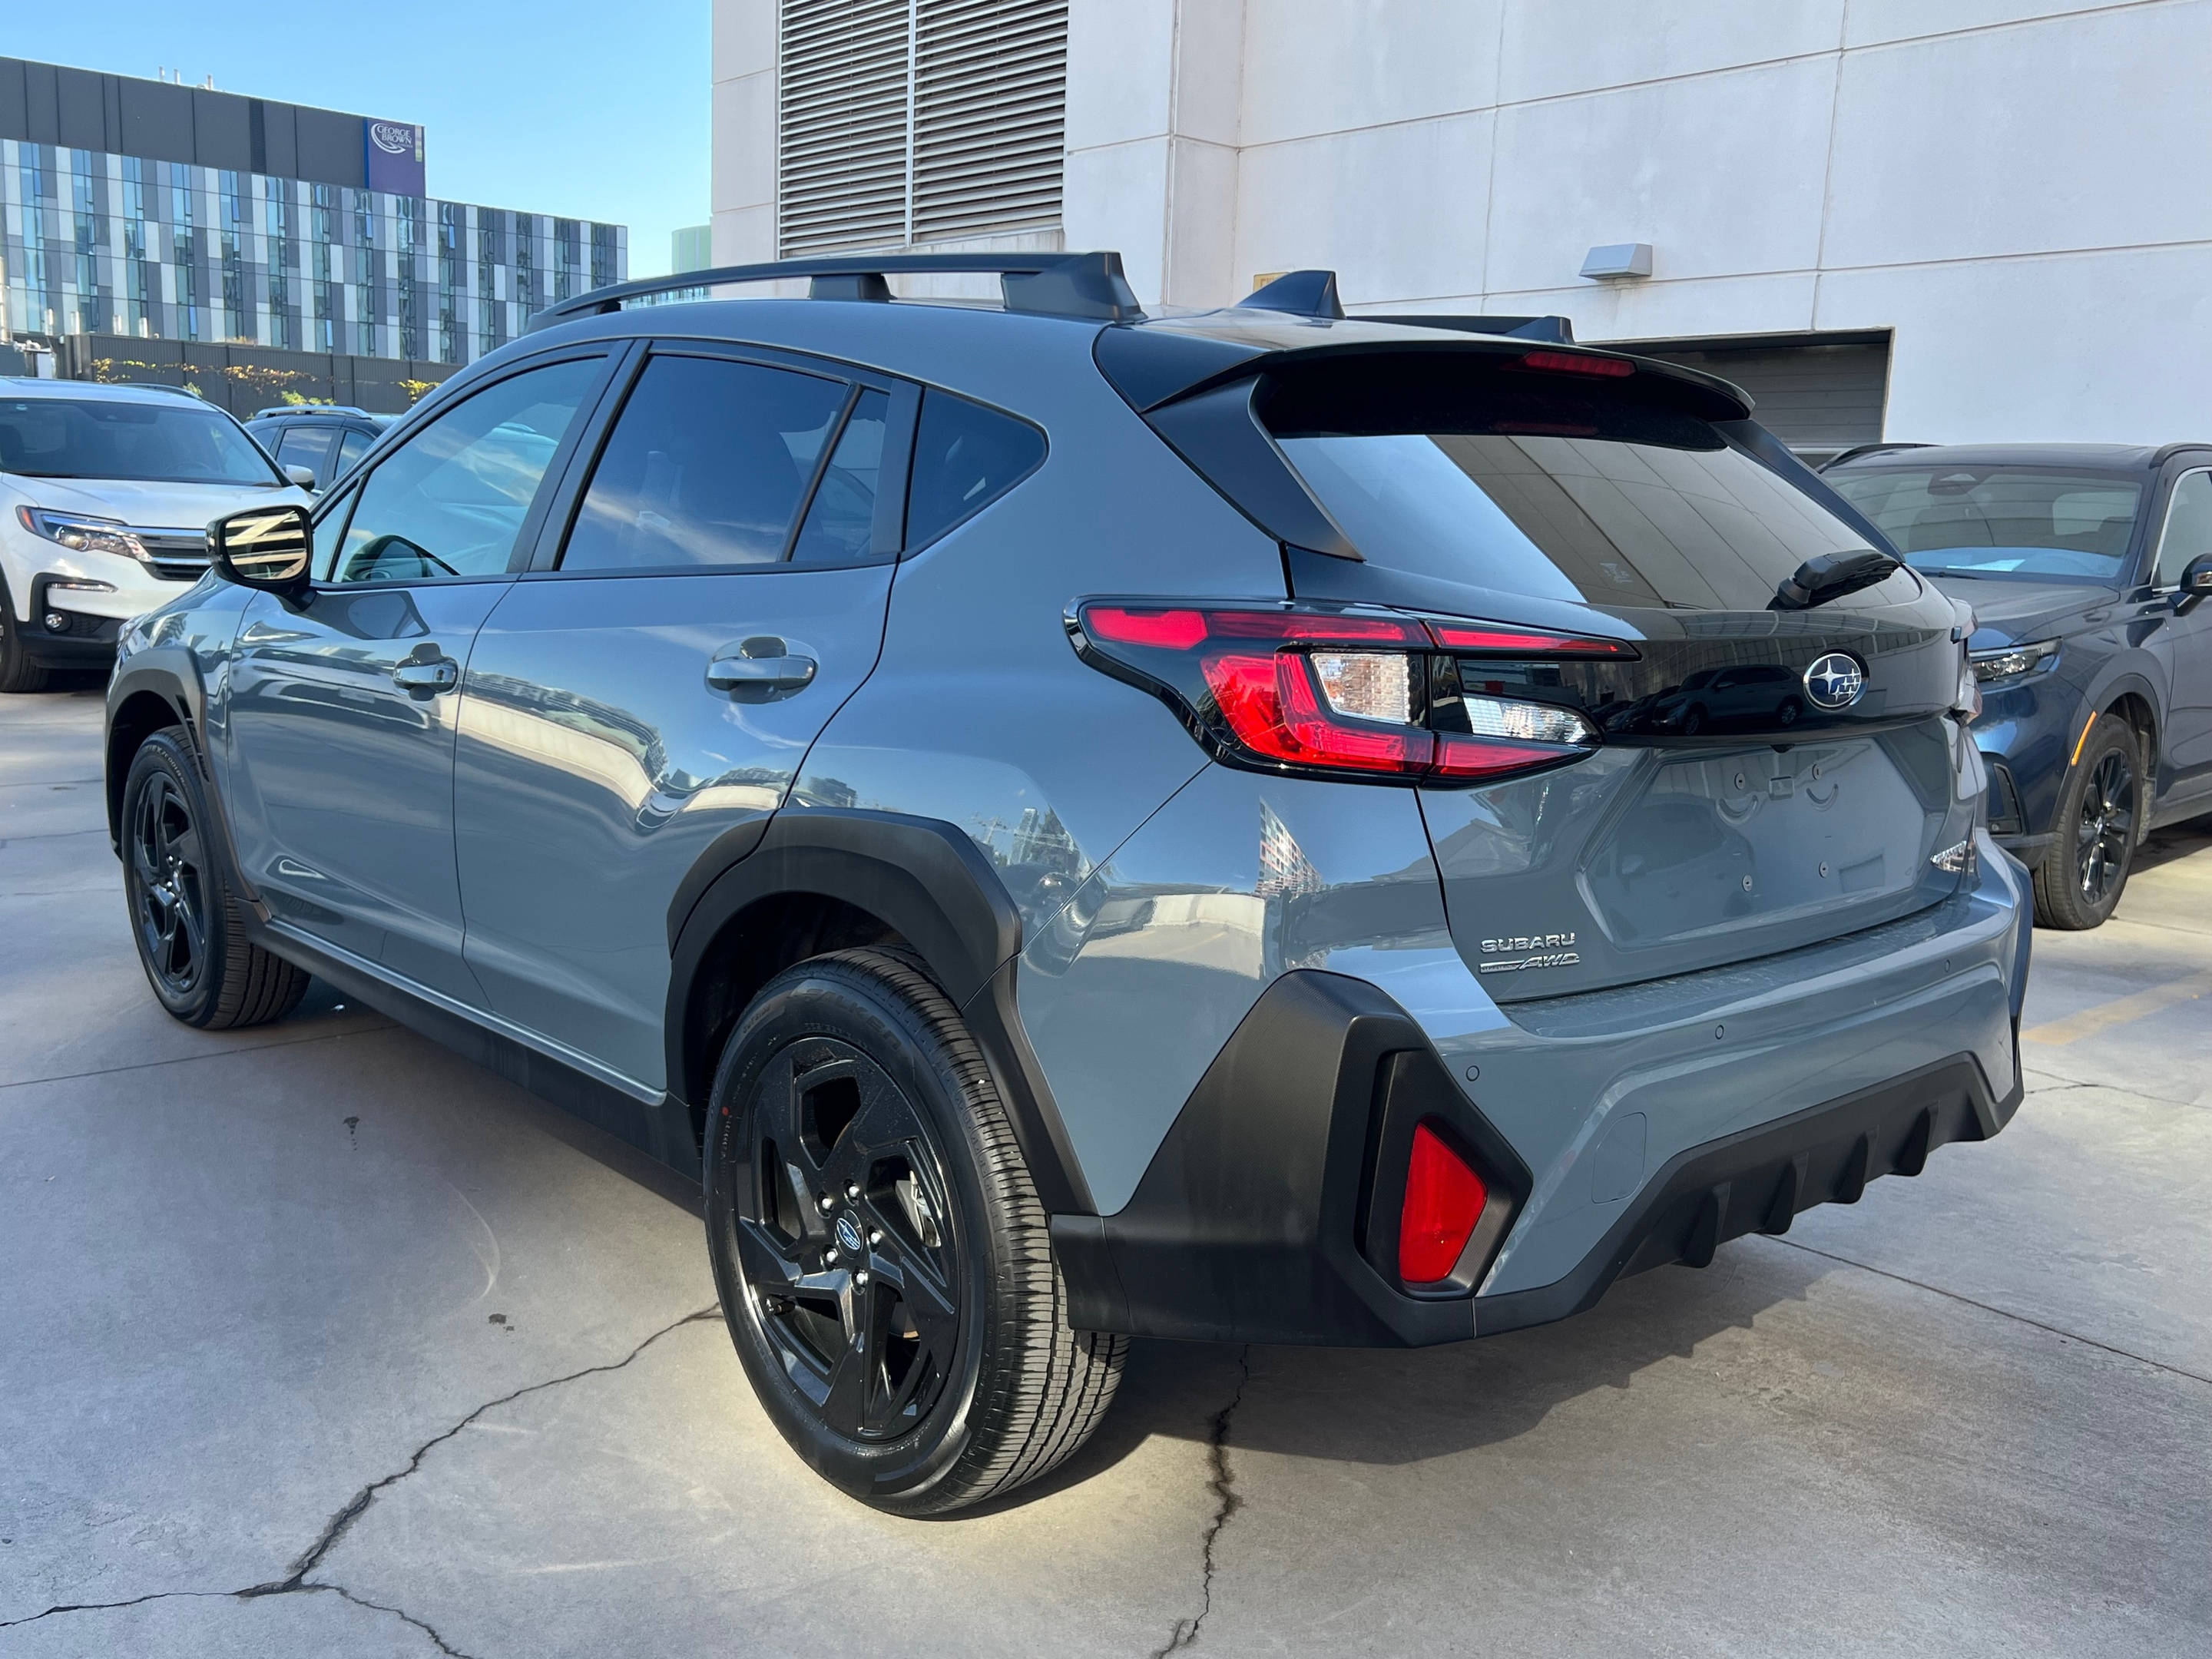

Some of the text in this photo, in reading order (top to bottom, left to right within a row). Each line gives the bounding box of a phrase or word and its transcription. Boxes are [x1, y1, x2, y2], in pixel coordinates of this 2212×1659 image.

[377, 125, 411, 137] GEORGE
[382, 133, 412, 144] BROWN
[1480, 932, 1575, 953] SUBARU
[1518, 952, 1581, 970] AWD
